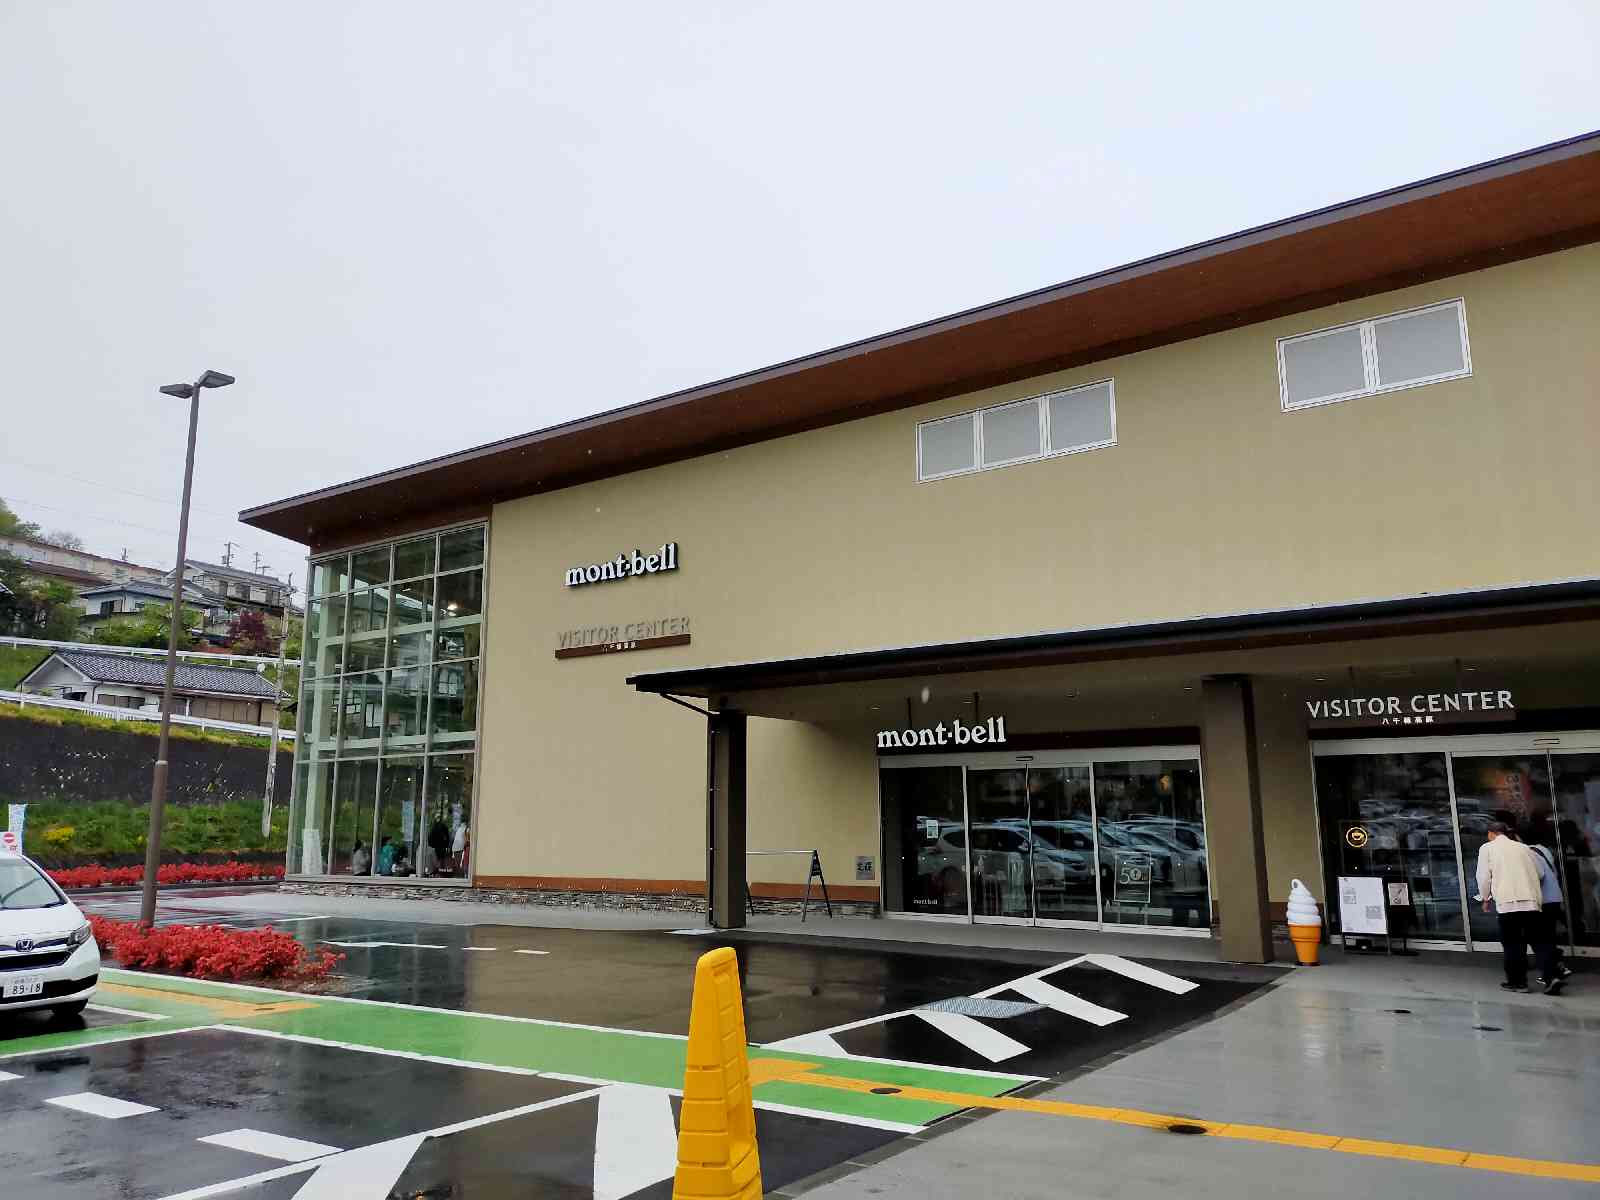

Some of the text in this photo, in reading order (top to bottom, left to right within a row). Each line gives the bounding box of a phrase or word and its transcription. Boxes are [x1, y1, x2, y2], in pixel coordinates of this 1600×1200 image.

[558, 625, 619, 648] VISITOR
[624, 616, 690, 640] CENTER
[1306, 690, 1515, 719] VISITOR CENTER
